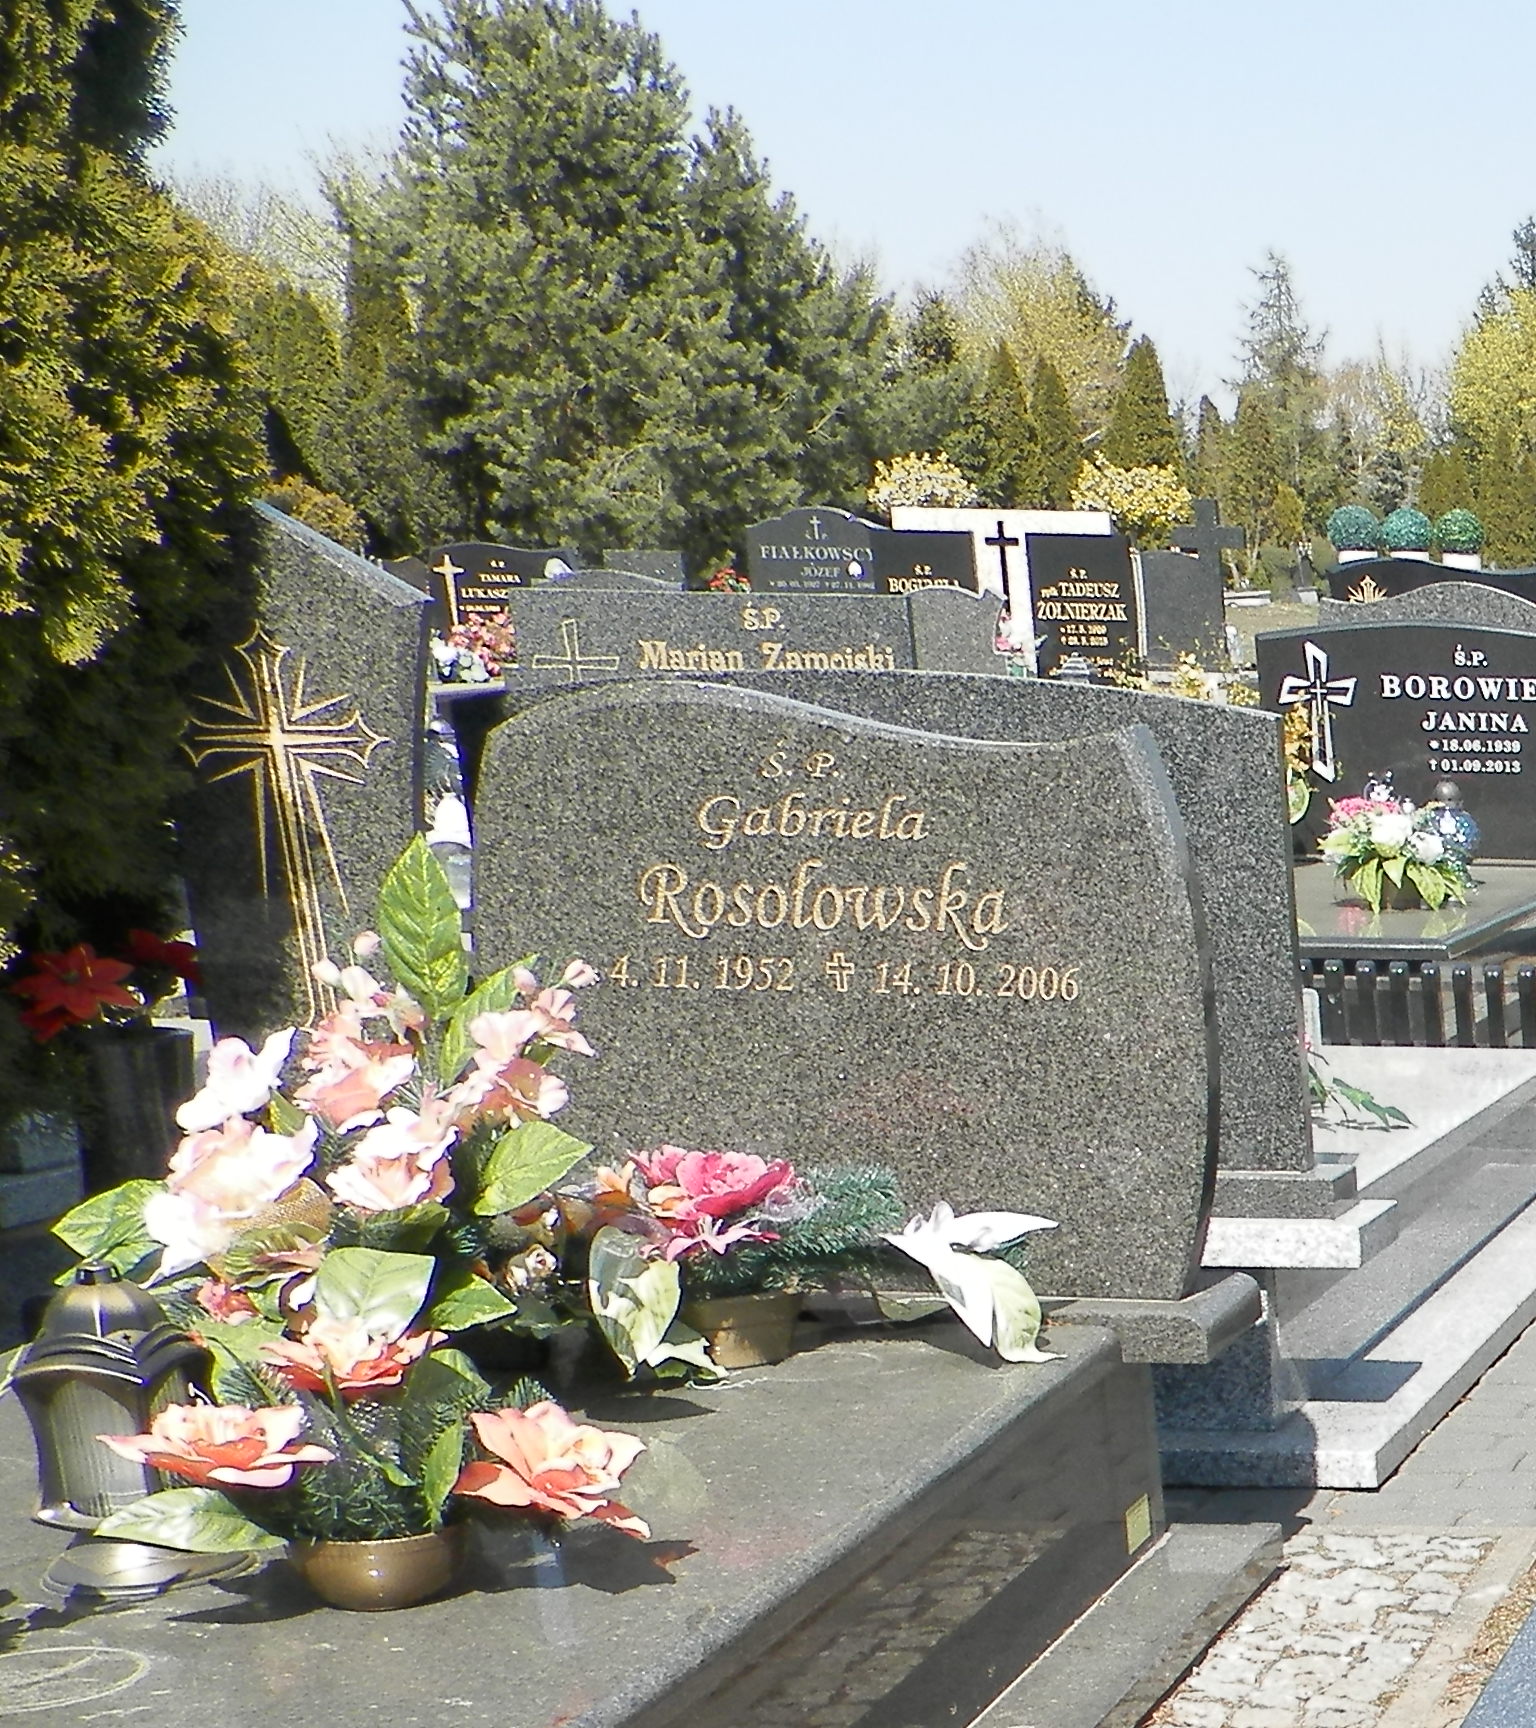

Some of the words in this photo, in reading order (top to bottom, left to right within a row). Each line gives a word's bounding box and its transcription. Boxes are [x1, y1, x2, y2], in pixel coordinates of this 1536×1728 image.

[1059, 581, 1121, 599] TADEUSZ
[639, 639, 744, 671] Marian
[1421, 710, 1529, 733] JANINA
[698, 793, 930, 850] Gabriela
